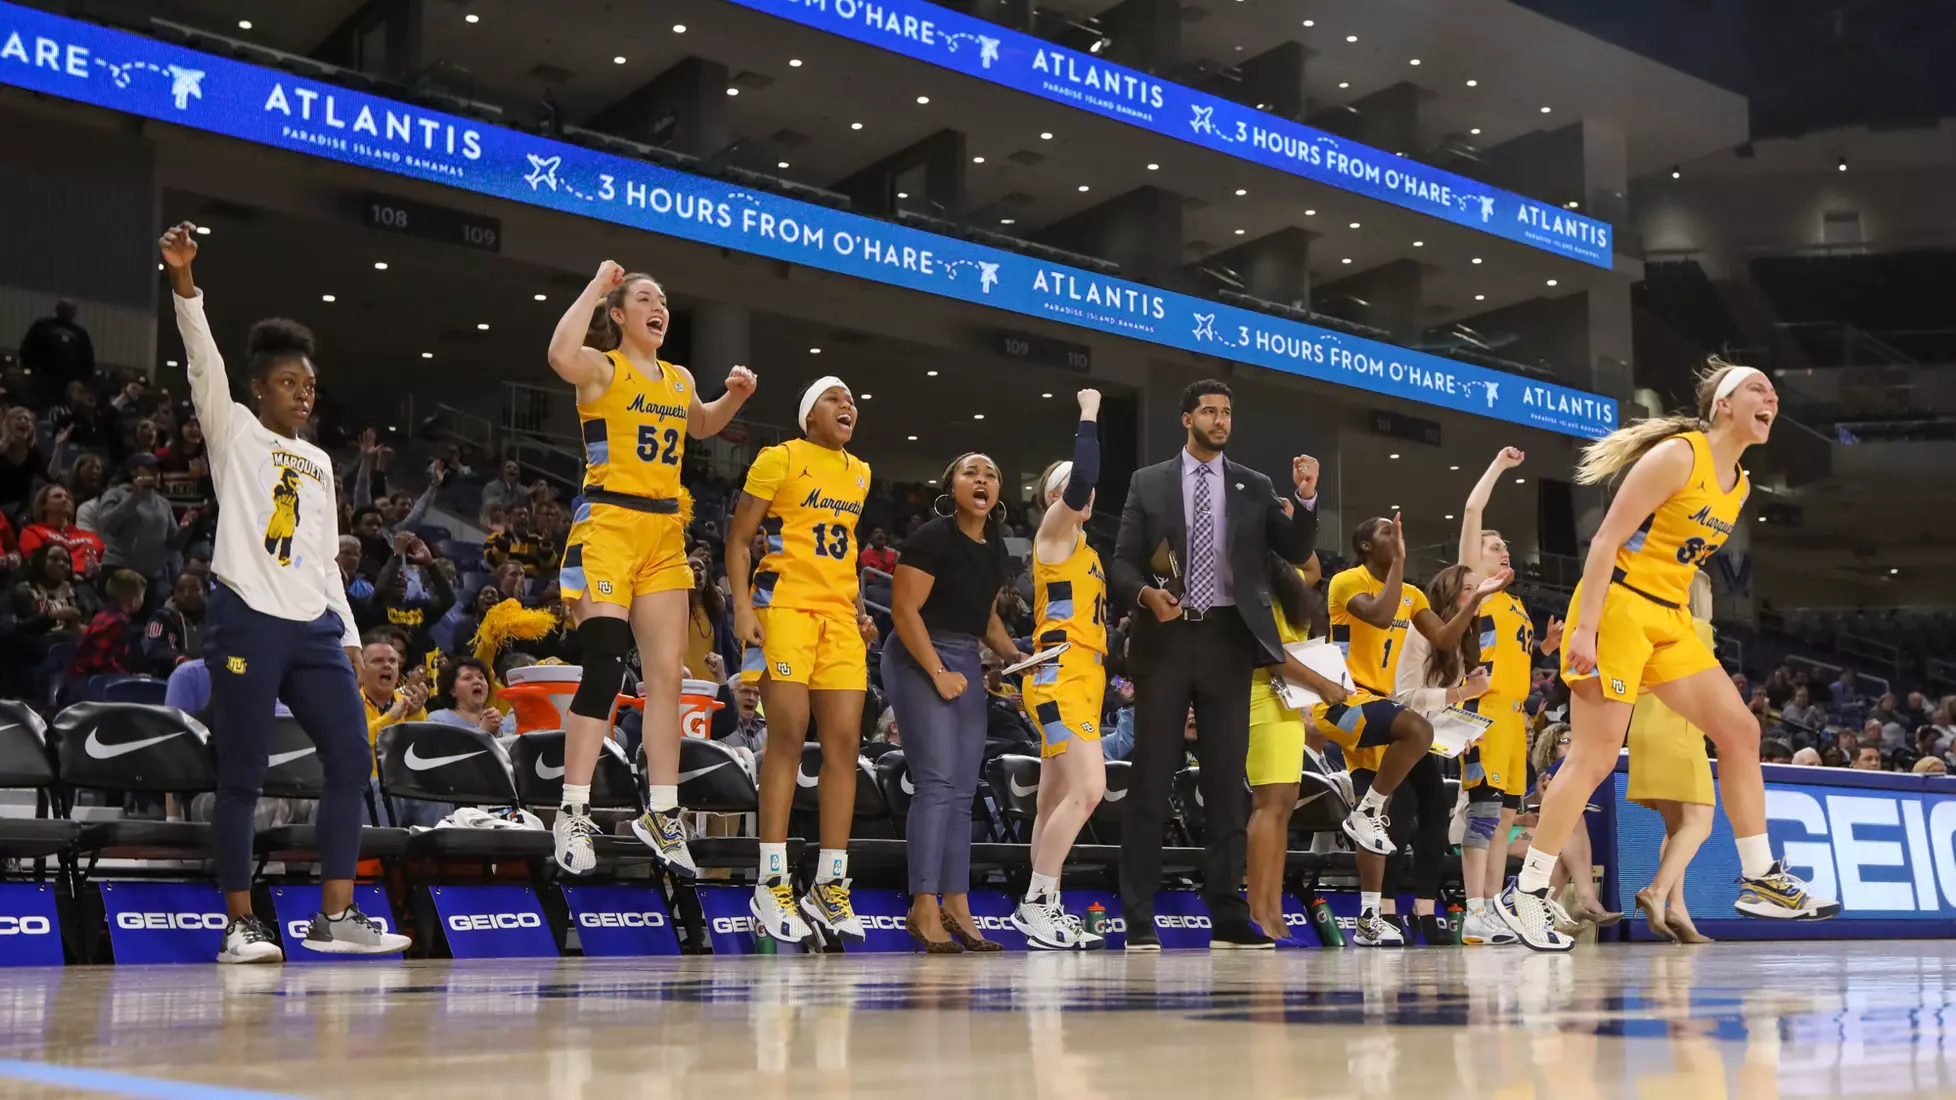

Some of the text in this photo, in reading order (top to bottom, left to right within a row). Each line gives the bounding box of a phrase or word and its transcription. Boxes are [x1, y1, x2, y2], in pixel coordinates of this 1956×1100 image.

[834, 0, 935, 45] O'HARE
[1032, 48, 1164, 108] ATLANTIS
[1043, 81, 1153, 122] PARADISE ISLAND BAHAMAS
[265, 82, 482, 160] ATLANTIS
[282, 125, 464, 178] PARADISE ISLAND BAHAMAS
[1235, 121, 1451, 206] 3 HOURS FROM O'HARE
[371, 204, 408, 228] 108
[462, 224, 497, 246] 109
[598, 173, 934, 275] 3 HOURS FROM O'HARE
[1518, 204, 1607, 248] ATLANTIS
[1033, 268, 1166, 320] ATLANTIS
[1043, 302, 1155, 334] PARADISE ISLAND BAHAMAS
[1004, 338, 1029, 356] 109
[1067, 351, 1088, 368] 110
[1238, 326, 1456, 394] 3 HOURS FROM O'HARE
[1523, 386, 1613, 424] ATLANTIS
[636, 424, 680, 467] 52
[811, 522, 849, 560] 13
[1381, 638, 1394, 668] 1
[1516, 623, 1534, 656] 42
[682, 711, 706, 739] G
[1765, 789, 1956, 911] GEI
[116, 912, 230, 930] GEICO
[448, 912, 541, 931] GEICO
[579, 911, 664, 928] GEICO
[1154, 914, 1213, 929] GEICO
